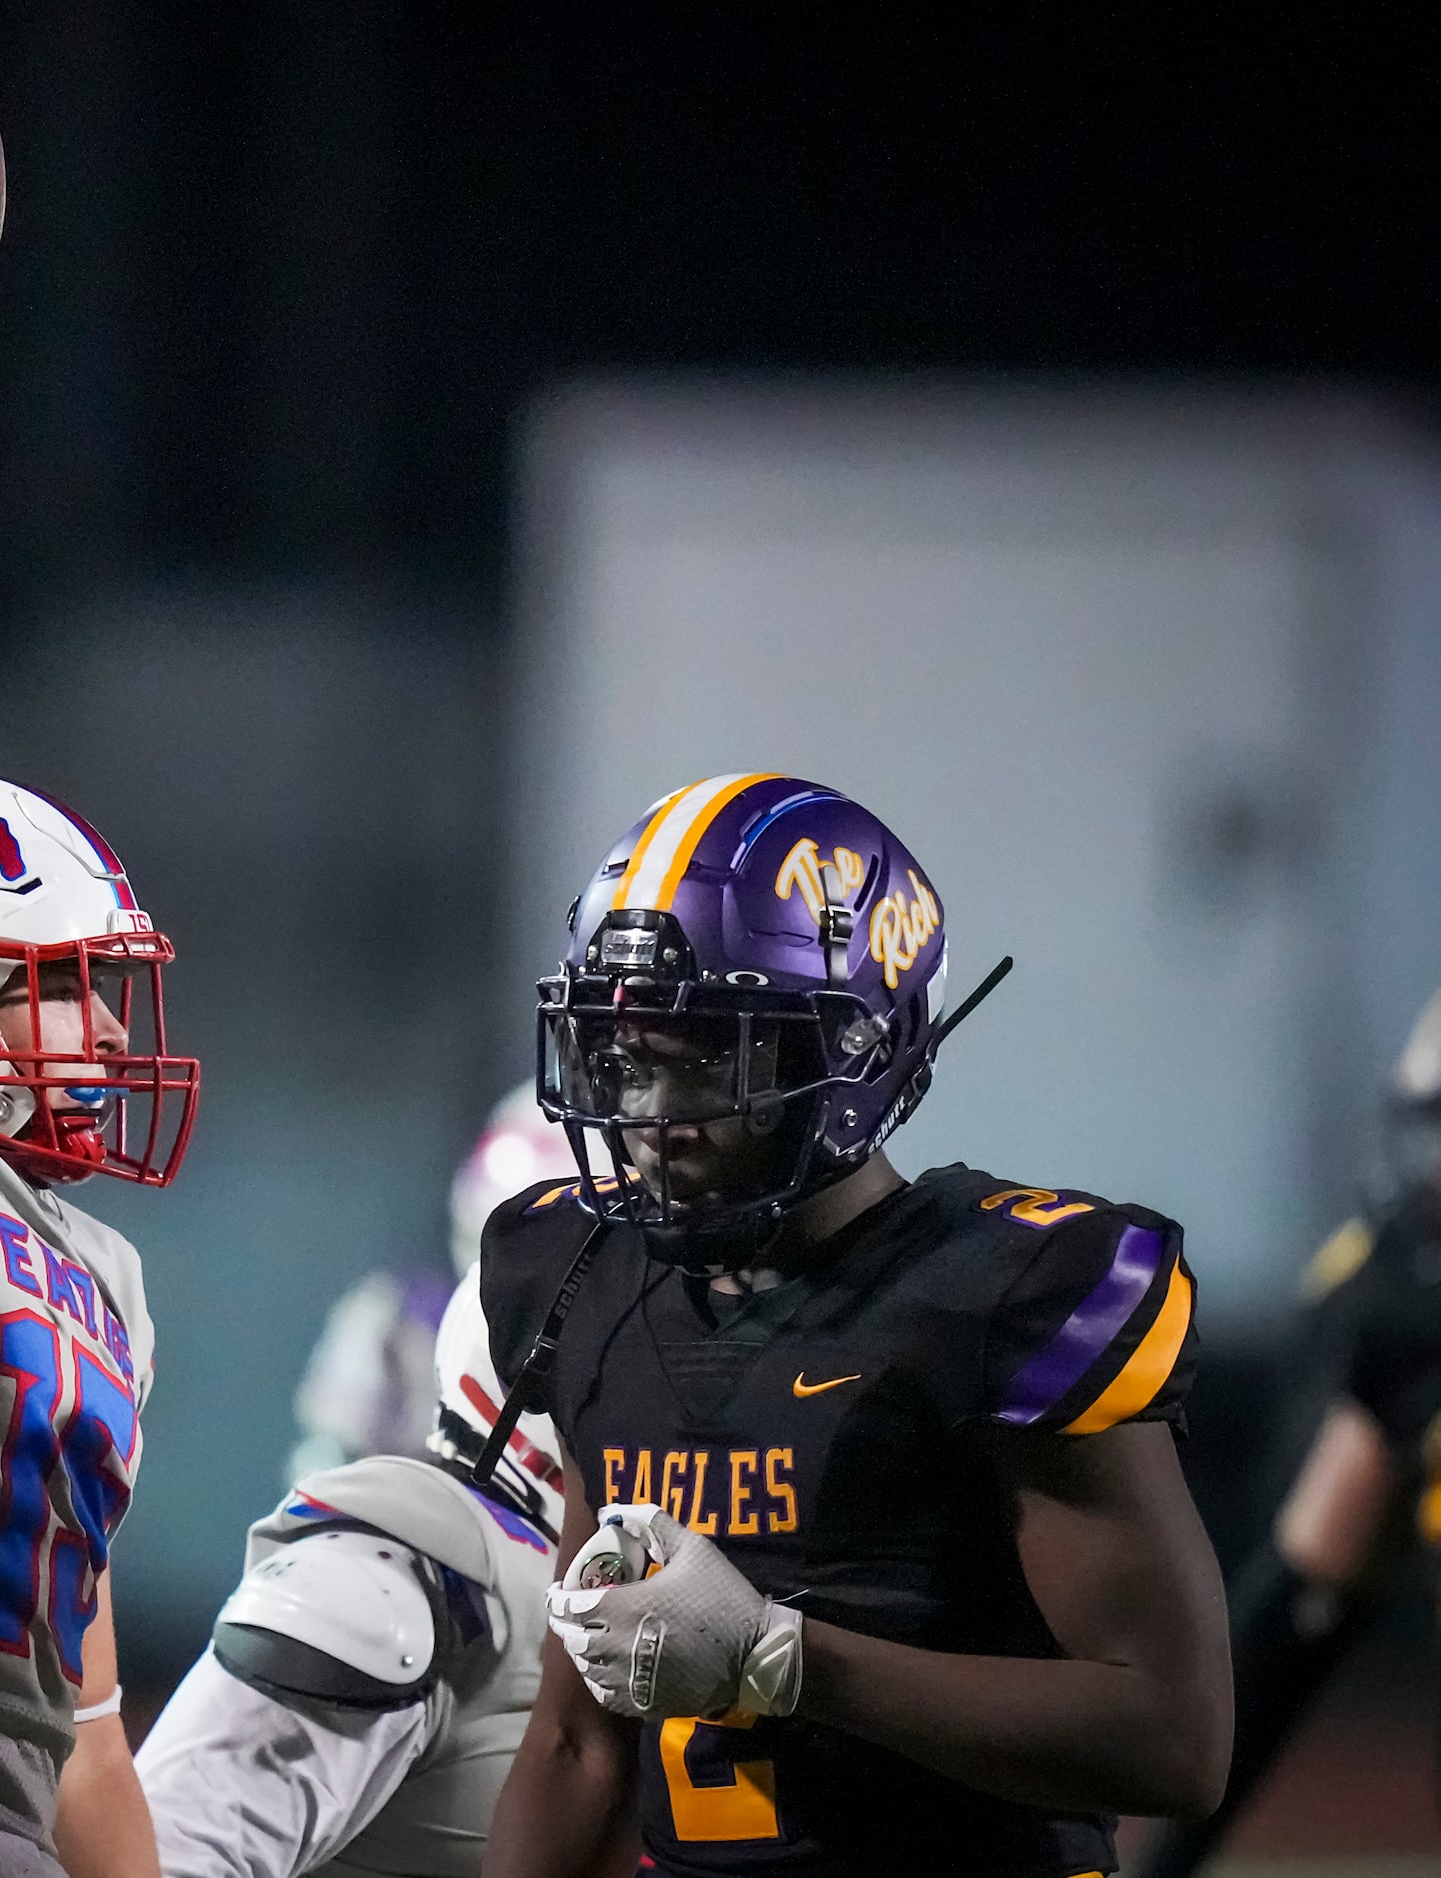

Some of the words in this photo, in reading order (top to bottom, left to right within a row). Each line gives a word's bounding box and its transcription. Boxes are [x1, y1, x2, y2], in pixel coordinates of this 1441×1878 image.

[869, 869, 939, 989] Rich
[979, 1188, 1096, 1229] 2
[602, 1446, 799, 1536] EAGLES
